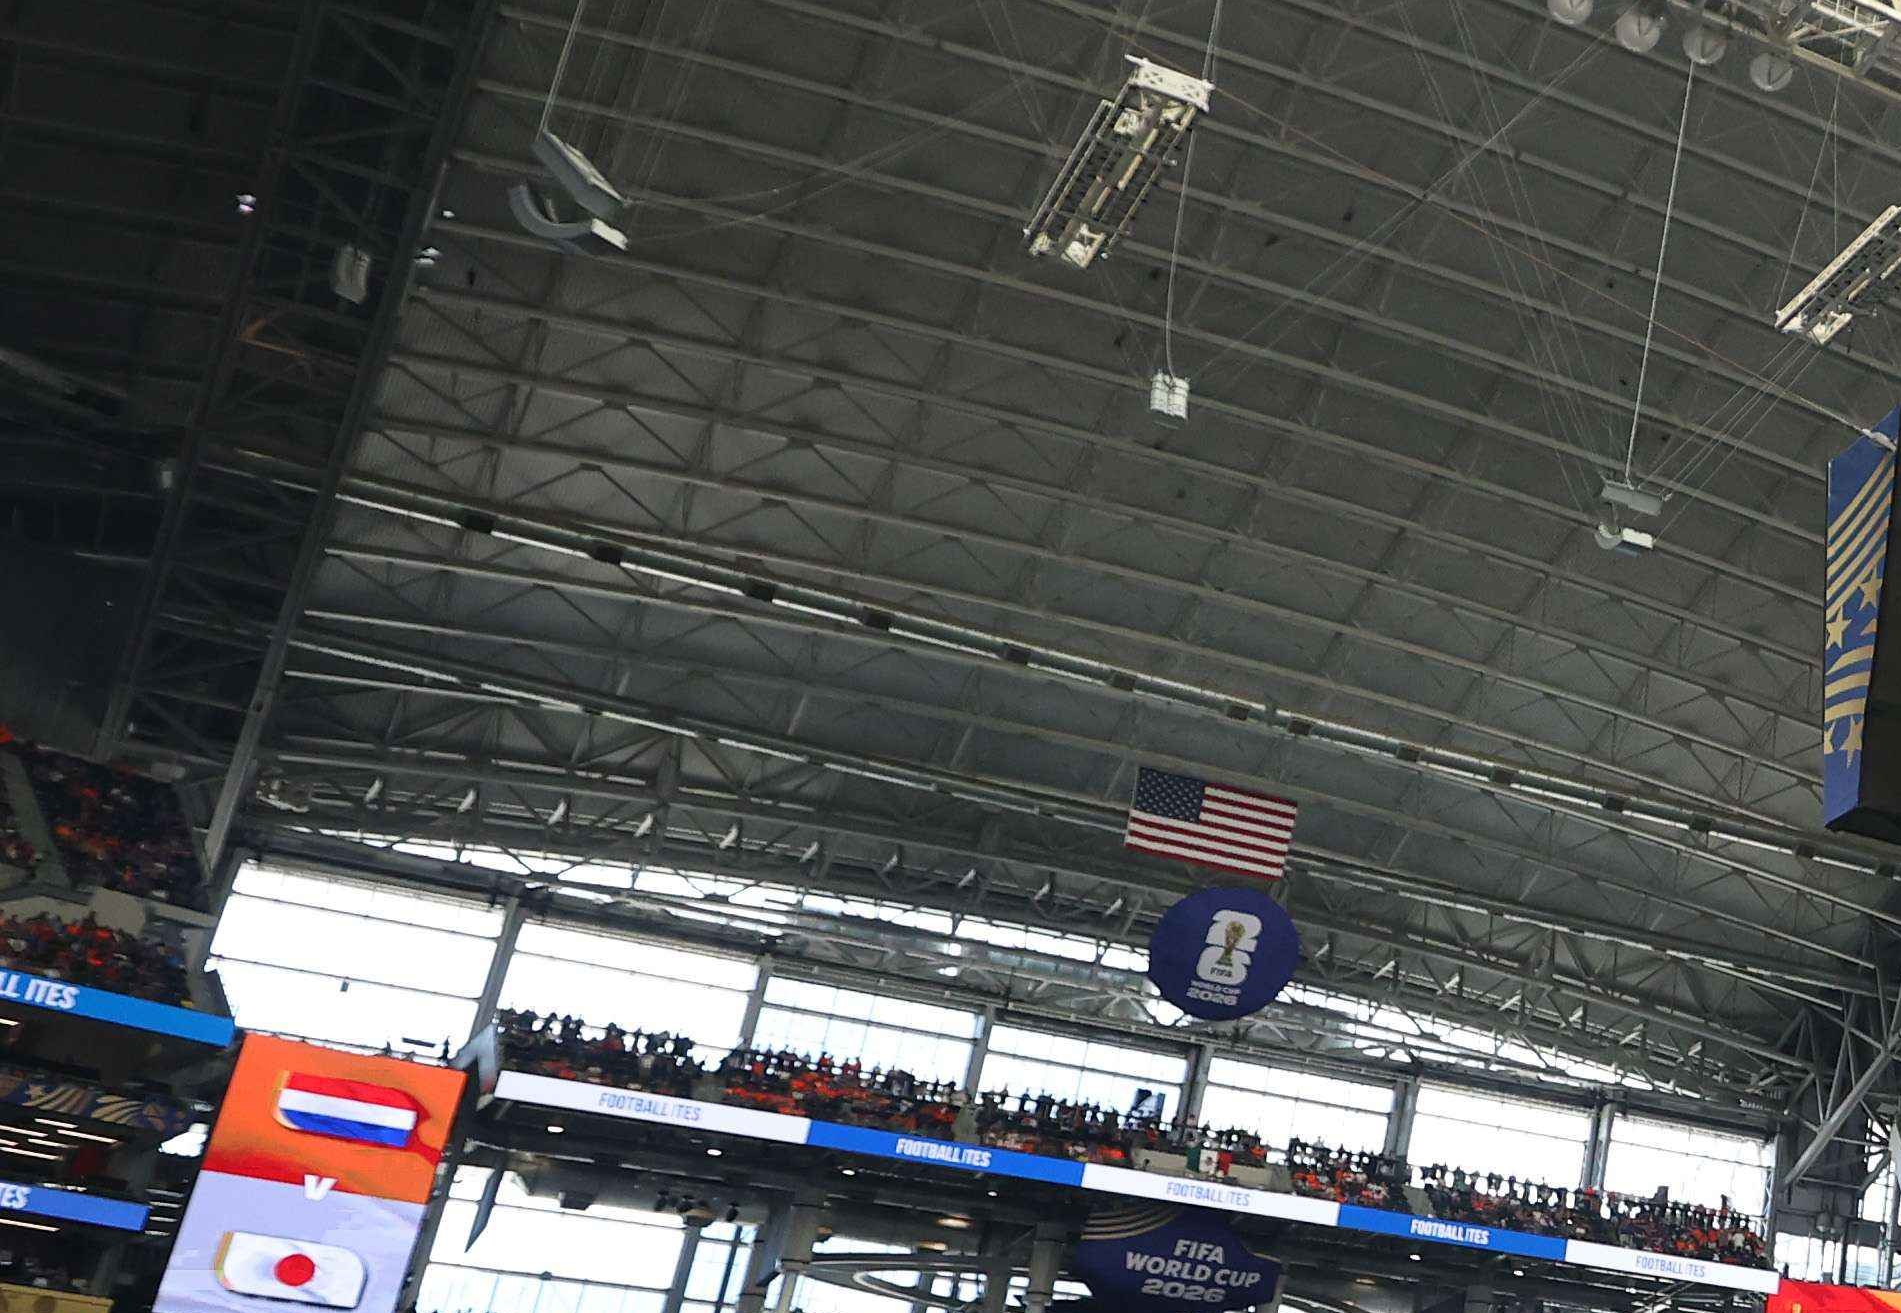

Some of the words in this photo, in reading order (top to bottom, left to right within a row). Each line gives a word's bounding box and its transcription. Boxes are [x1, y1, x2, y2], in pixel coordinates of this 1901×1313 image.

[1173, 1239, 1224, 1264] FIFA
[1126, 1251, 1211, 1281] WORLD
[1214, 1269, 1261, 1287] CUP
[1141, 1279, 1226, 1302] 2026
